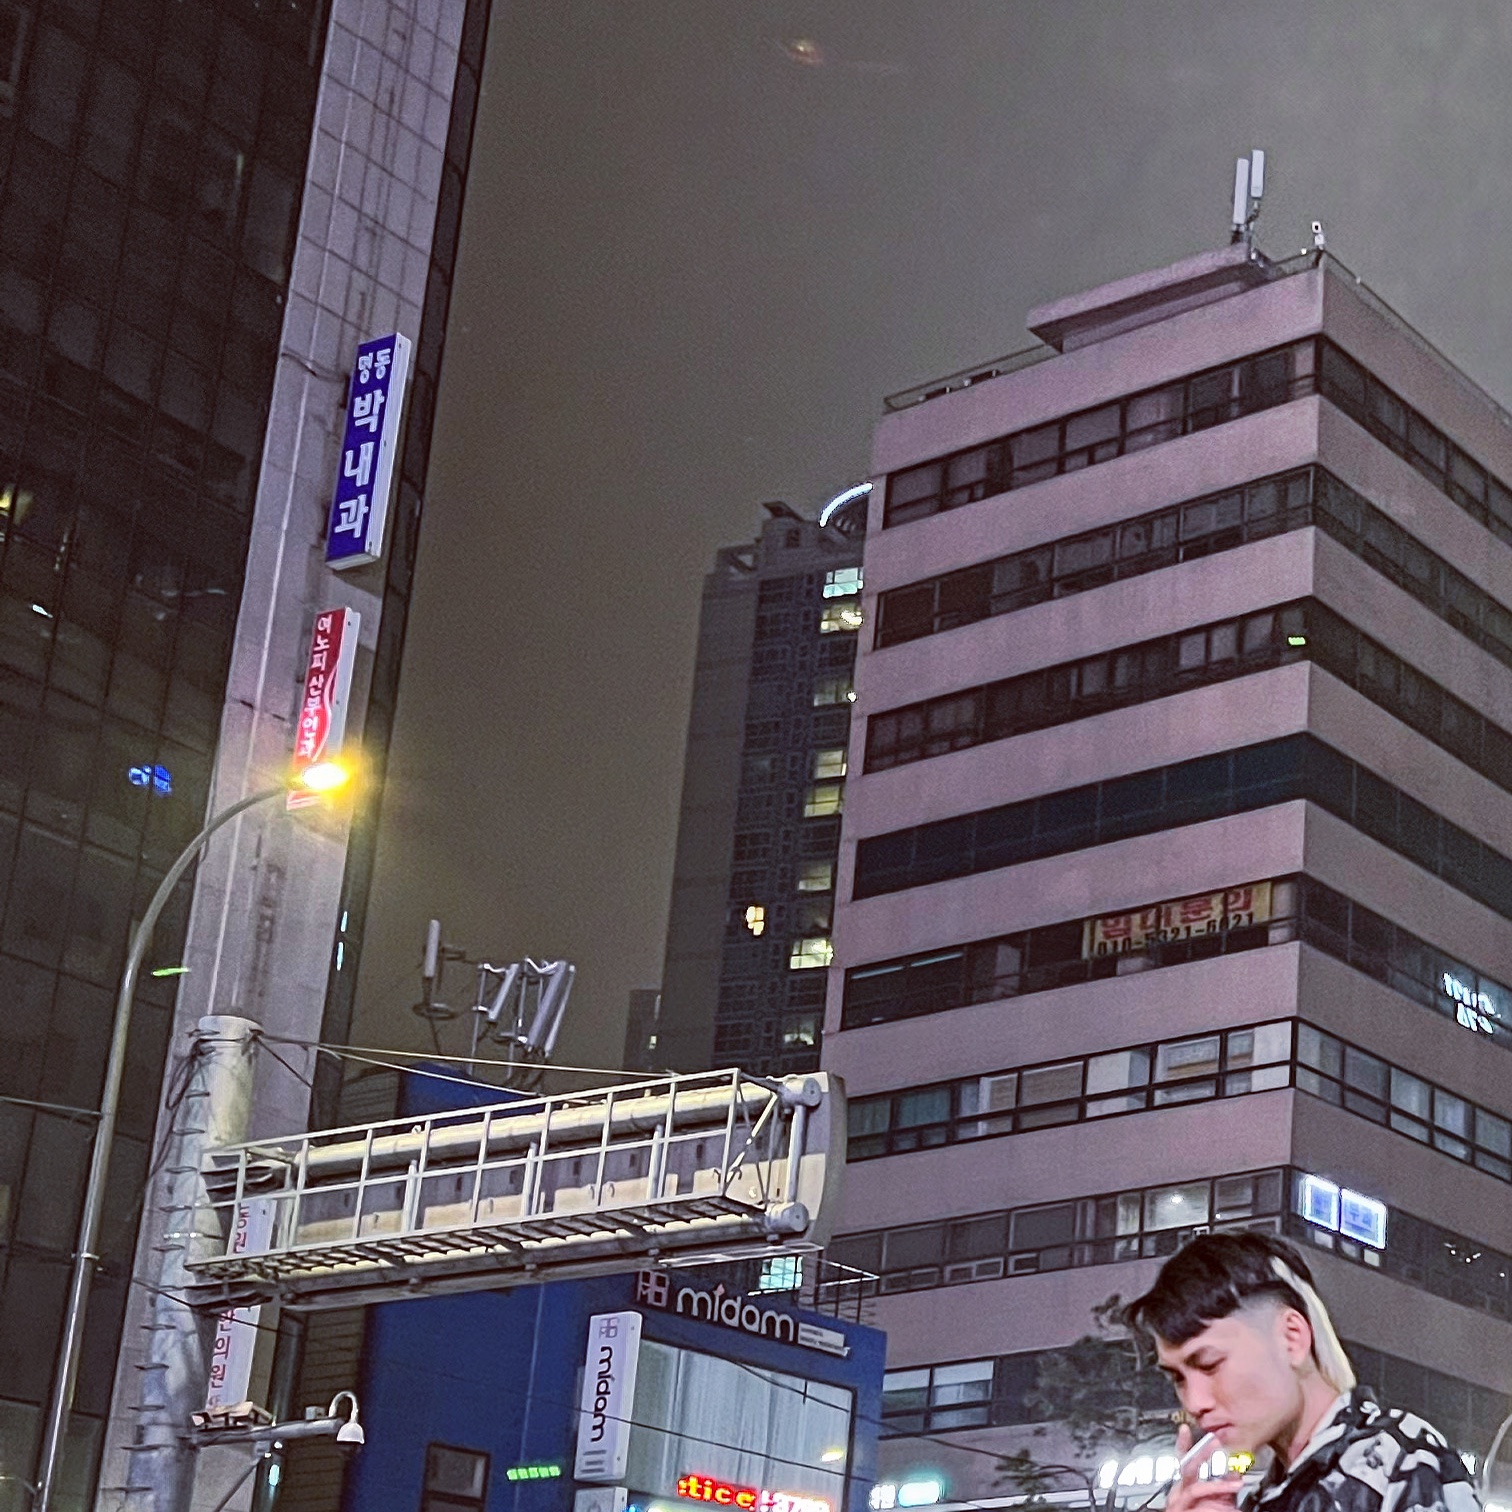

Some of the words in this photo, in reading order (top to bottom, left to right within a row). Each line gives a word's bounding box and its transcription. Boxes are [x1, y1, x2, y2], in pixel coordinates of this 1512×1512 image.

[358, 347, 391, 384] 명동
[334, 388, 385, 539] 박내과
[676, 1283, 795, 1342] midam
[590, 1345, 616, 1443] midam
